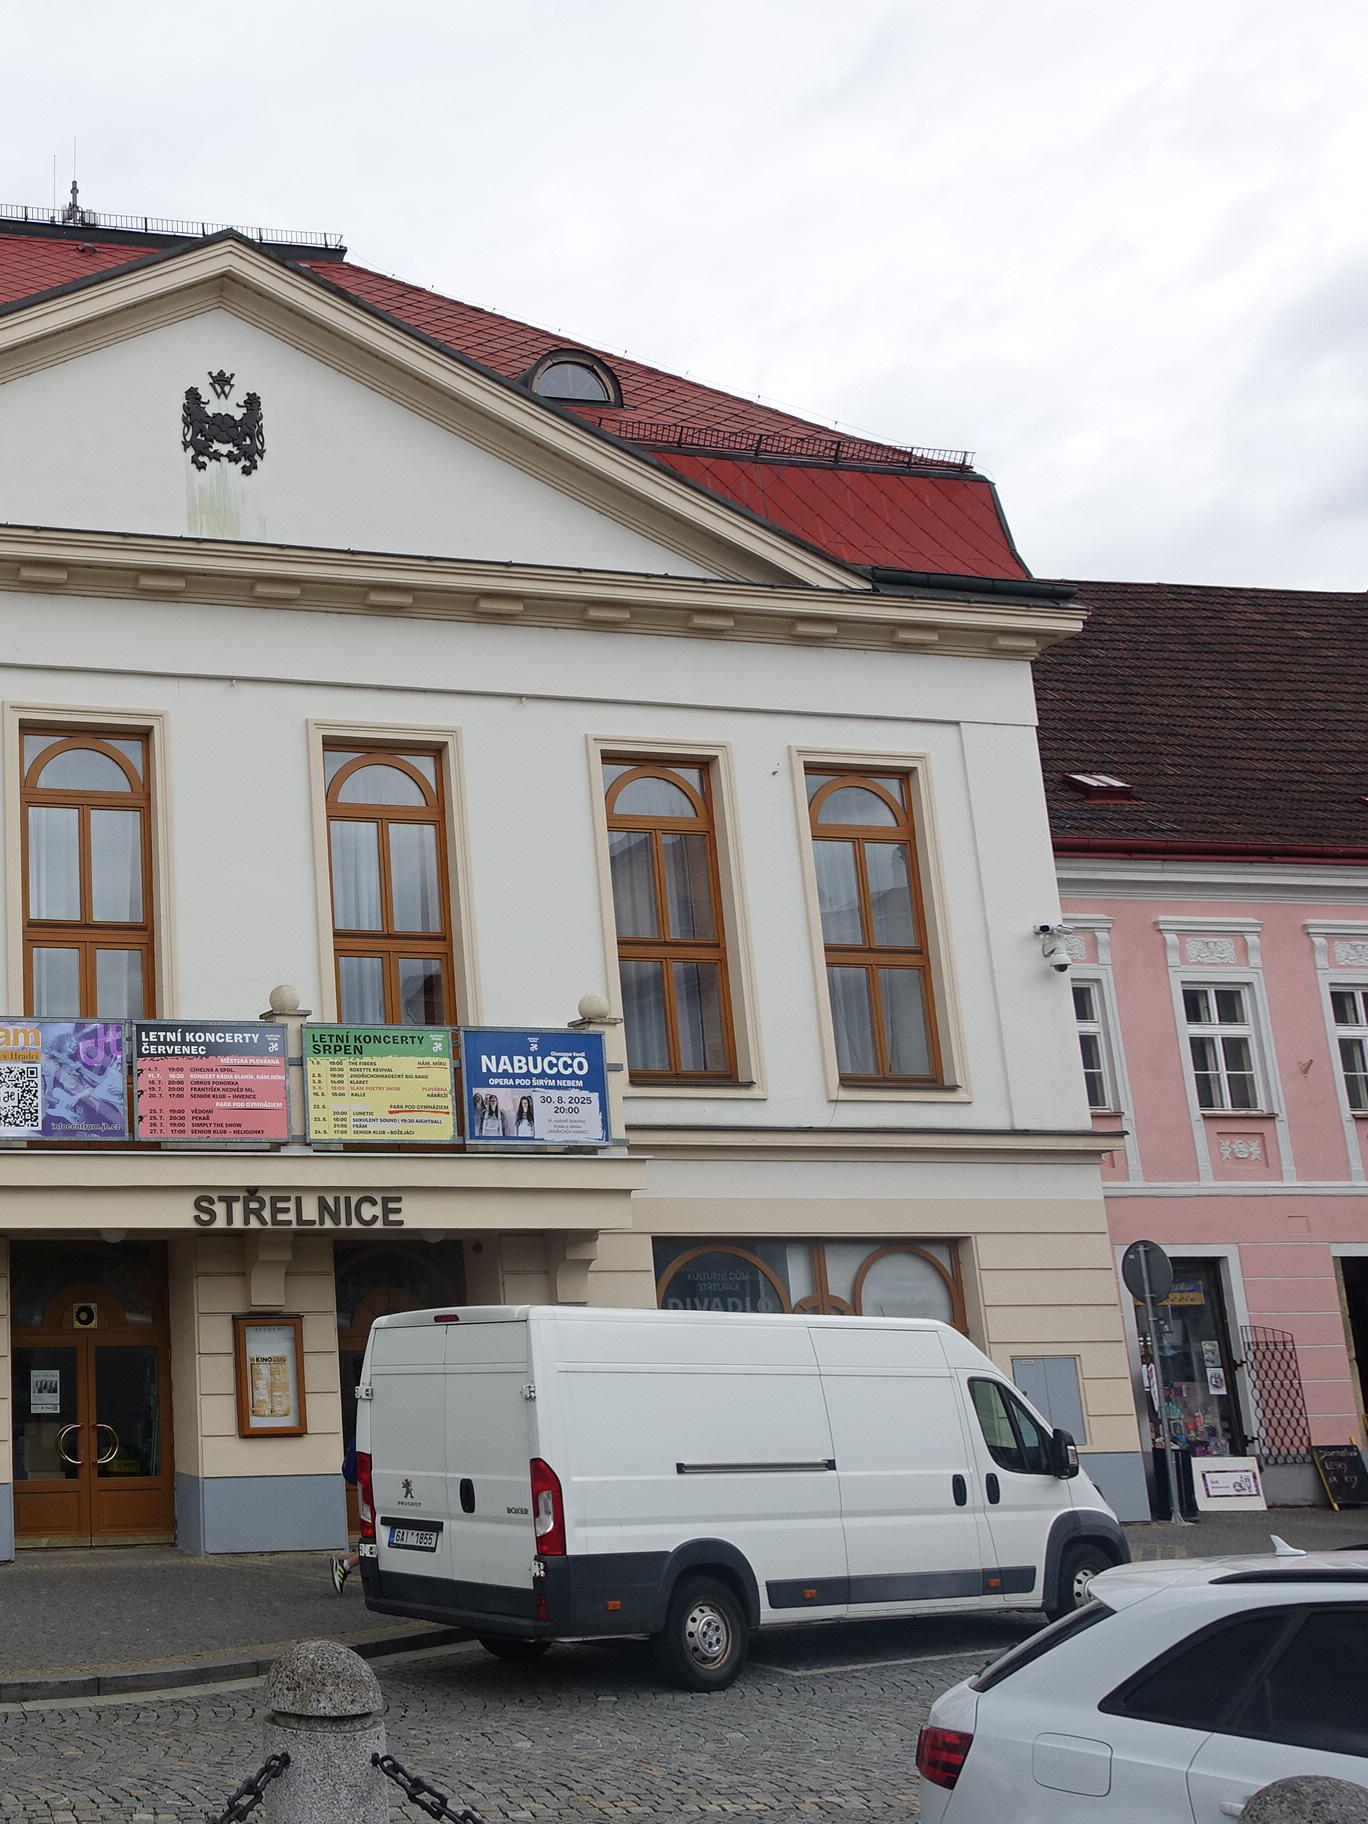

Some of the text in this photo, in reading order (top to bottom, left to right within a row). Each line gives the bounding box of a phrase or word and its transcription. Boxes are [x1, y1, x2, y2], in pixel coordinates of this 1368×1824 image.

[142, 1028, 182, 1042] LETNÍ
[186, 1032, 259, 1043] KONCERTY
[312, 1031, 350, 1044] LETNÍ
[354, 1035, 424, 1045] KONCERTY
[142, 1042, 207, 1055] ČERVENEC
[312, 1044, 363, 1055] SRPEN
[481, 1055, 589, 1075] NABUCCO
[532, 1077, 556, 1086] ŠIRÝM
[540, 1096, 592, 1105] 30. 8. 2025
[554, 1106, 580, 1114] 20:00
[52, 1122, 121, 1132] infocentrum.jh.cz
[194, 1188, 404, 1227] STŘELNICE
[507, 1507, 529, 1515] BOXER
[416, 1532, 433, 1546] 1855
